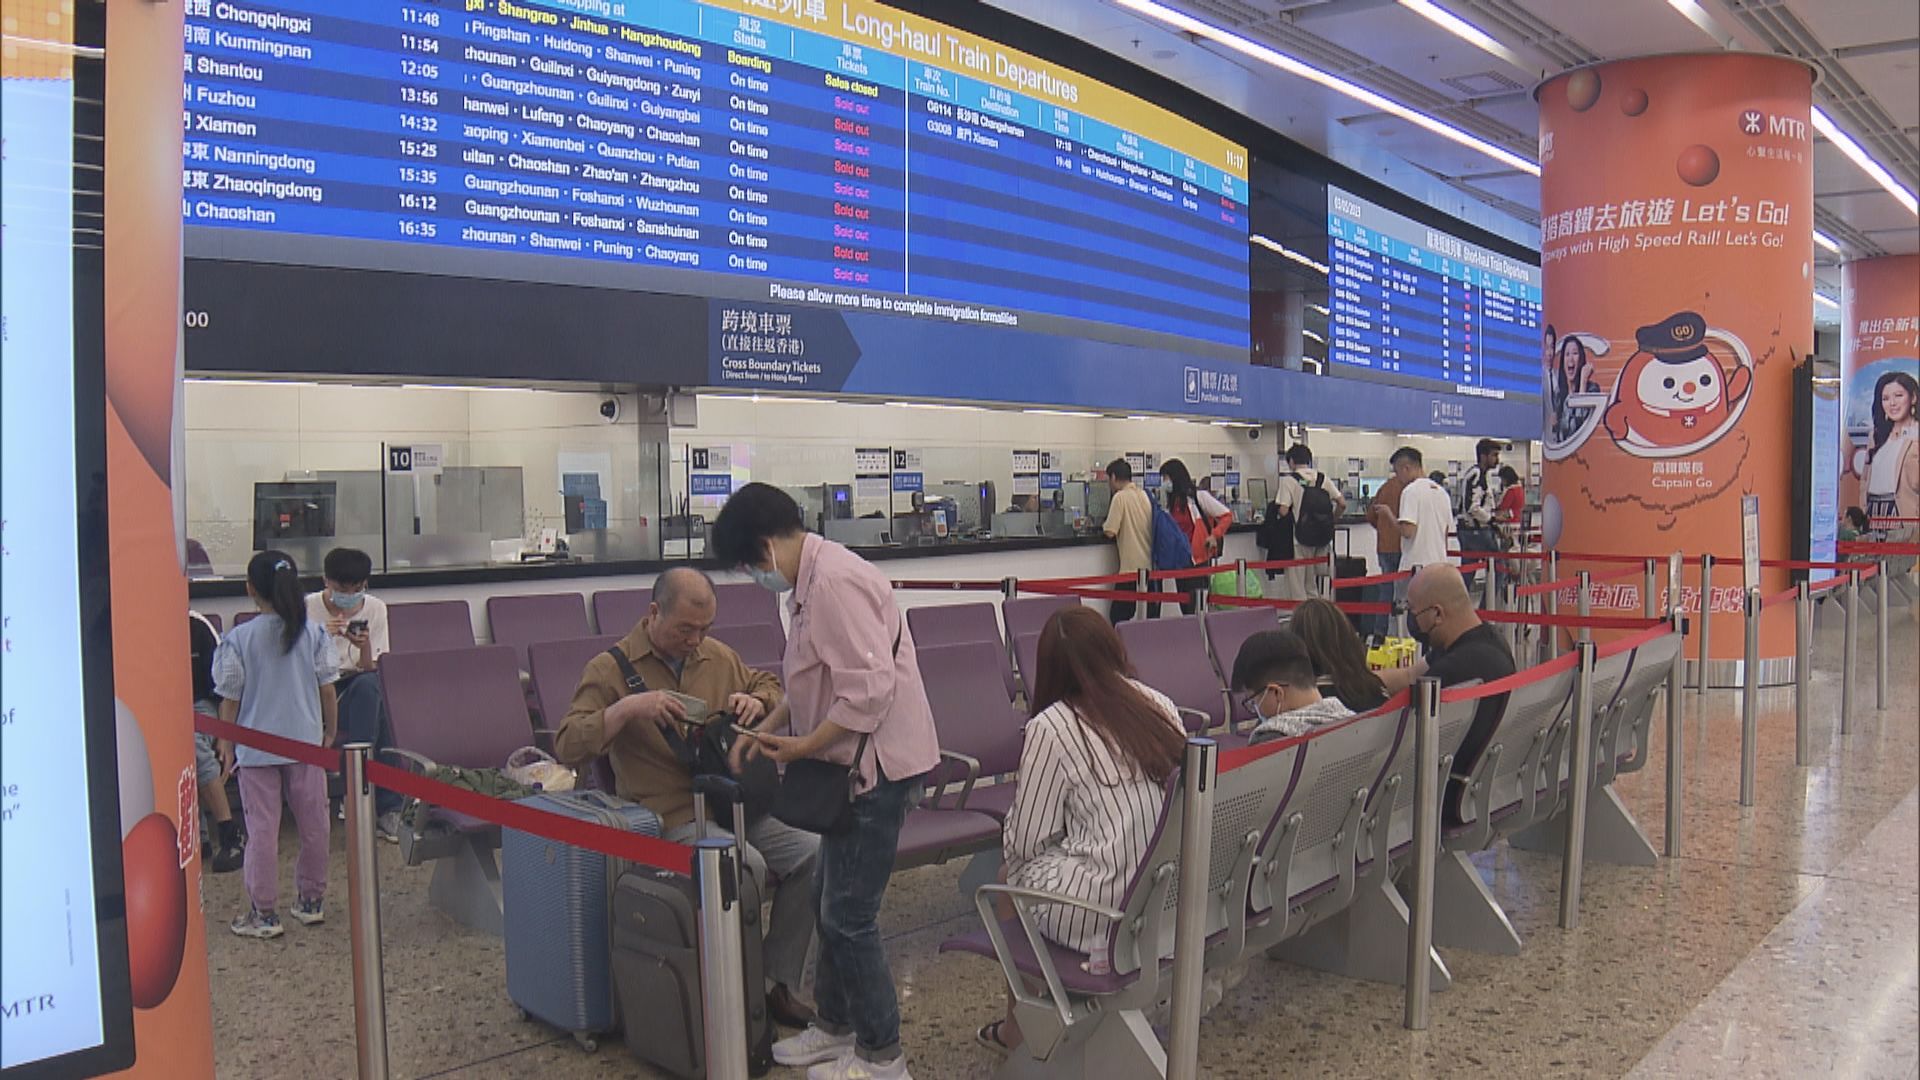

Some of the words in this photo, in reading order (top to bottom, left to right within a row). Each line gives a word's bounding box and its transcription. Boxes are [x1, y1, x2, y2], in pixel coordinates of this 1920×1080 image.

[216, 2, 311, 33] Chongqingxi
[402, 8, 439, 27] 11:48
[498, 1, 558, 25] Shangrao
[570, 17, 609, 35] Jinhua
[620, 26, 701, 58] Hangzhoudong
[216, 30, 312, 59] Kunmingnan
[402, 34, 439, 54] 11:54
[733, 30, 766, 49] Status
[472, 20, 531, 44] Pingshan
[544, 34, 593, 58] Huidong
[605, 46, 653, 67] Shanwei
[664, 58, 701, 79] Puning
[842, 3, 940, 57] Long-haul
[947, 36, 990, 74] Train
[996, 53, 1078, 103] Departures
[198, 57, 262, 81] Shantou
[401, 60, 438, 79] 12:05
[728, 50, 771, 73] Boarding
[836, 56, 868, 75] Tickets
[529, 56, 574, 77] Guilinxi
[586, 67, 661, 95] Guiyangdong
[671, 84, 701, 103] Zunyi
[730, 73, 746, 88] On
[748, 75, 768, 92] time
[825, 73, 849, 92] Sales
[851, 80, 879, 97] closed
[914, 77, 935, 94] Train
[936, 85, 950, 97] No.
[197, 86, 256, 108] Fuzhou
[400, 87, 438, 105] 13:56
[481, 72, 574, 101] Guangzhounan
[587, 91, 629, 111] Guilinxi
[640, 101, 700, 123] Guiyangbei
[730, 95, 745, 110] On
[748, 98, 768, 115] time
[834, 96, 854, 112] Sold
[856, 103, 870, 115] out
[196, 114, 256, 136] Xiamen
[400, 114, 438, 132] 14:32
[522, 105, 564, 127] Lufeng
[576, 114, 635, 138] Chaoyang
[646, 125, 700, 147] Chaoshan
[730, 118, 745, 132] On
[748, 120, 768, 136] time
[834, 118, 854, 133] Sold
[856, 125, 870, 136] out
[1769, 114, 1805, 141] MTR
[400, 140, 437, 157] 15:25
[521, 130, 585, 153] Xiamenbei
[597, 142, 655, 164] Quanzhou
[666, 154, 699, 171] Putian
[729, 140, 745, 155] On
[747, 143, 768, 159] time
[834, 138, 853, 152] Sold
[855, 144, 869, 156] out
[214, 146, 315, 174] Nanningdong
[834, 160, 853, 175] Sold
[855, 166, 869, 178] out
[399, 167, 437, 184] 15:35
[508, 153, 570, 175] Chaoshan
[582, 164, 628, 183] Zhao'an
[640, 172, 699, 193] Zhangzhou
[729, 164, 745, 178] On
[747, 167, 768, 182] time
[213, 174, 322, 202] Zhaoqingdong
[465, 174, 559, 199] Guangzhounan
[572, 188, 624, 207] Foshanxi
[636, 196, 699, 217] Wuzhounan
[729, 186, 744, 200] On
[747, 188, 768, 204] time
[834, 182, 853, 196] Sold
[855, 188, 869, 199] out
[196, 201, 275, 223] Chaoshan
[399, 194, 437, 211] 16:12
[834, 202, 853, 216] Sold
[855, 208, 869, 219] out
[465, 200, 560, 224] Guangzhounan
[573, 212, 625, 231] Foshanxi
[636, 220, 699, 240] Sanshuinan
[729, 209, 744, 223] On
[747, 211, 768, 226] time
[1757, 200, 1789, 226] Go!
[399, 220, 436, 238] 16:35
[834, 224, 853, 238] Sold
[855, 230, 869, 241] out
[462, 226, 516, 245] zhounan
[529, 231, 581, 251] Shanwei
[593, 240, 633, 259] Puning
[645, 245, 699, 265] Chaoyang
[729, 230, 744, 245] On
[746, 234, 768, 249] time
[1569, 241, 1593, 256] with
[1598, 232, 1629, 253] High
[1634, 230, 1681, 251] Speed
[1687, 230, 1720, 246] Rail!
[1761, 232, 1784, 247] Go!
[728, 254, 744, 268] On
[746, 256, 767, 272] time
[834, 246, 853, 260] Sold
[855, 250, 869, 262] out
[834, 268, 853, 281] Sold
[854, 272, 869, 283] out
[770, 283, 805, 301] Please
[808, 288, 833, 304] allow
[835, 294, 860, 306] more
[861, 294, 881, 309] time
[883, 296, 892, 310] to
[894, 299, 933, 316] complete
[935, 303, 979, 321] immigration
[980, 308, 1018, 327] formalities
[186, 311, 209, 327] 00
[722, 309, 792, 335] 跨境車票
[722, 334, 804, 357] (直接往返香港)
[722, 357, 747, 369] Cross
[748, 358, 791, 374] Boundary
[792, 361, 821, 373] Tickets
[771, 373, 787, 383] Hong
[391, 452, 409, 466] 10
[695, 452, 706, 465] 11
[894, 453, 905, 467] 12
[1652, 477, 1692, 491] Captain
[1696, 478, 1712, 487] Go
